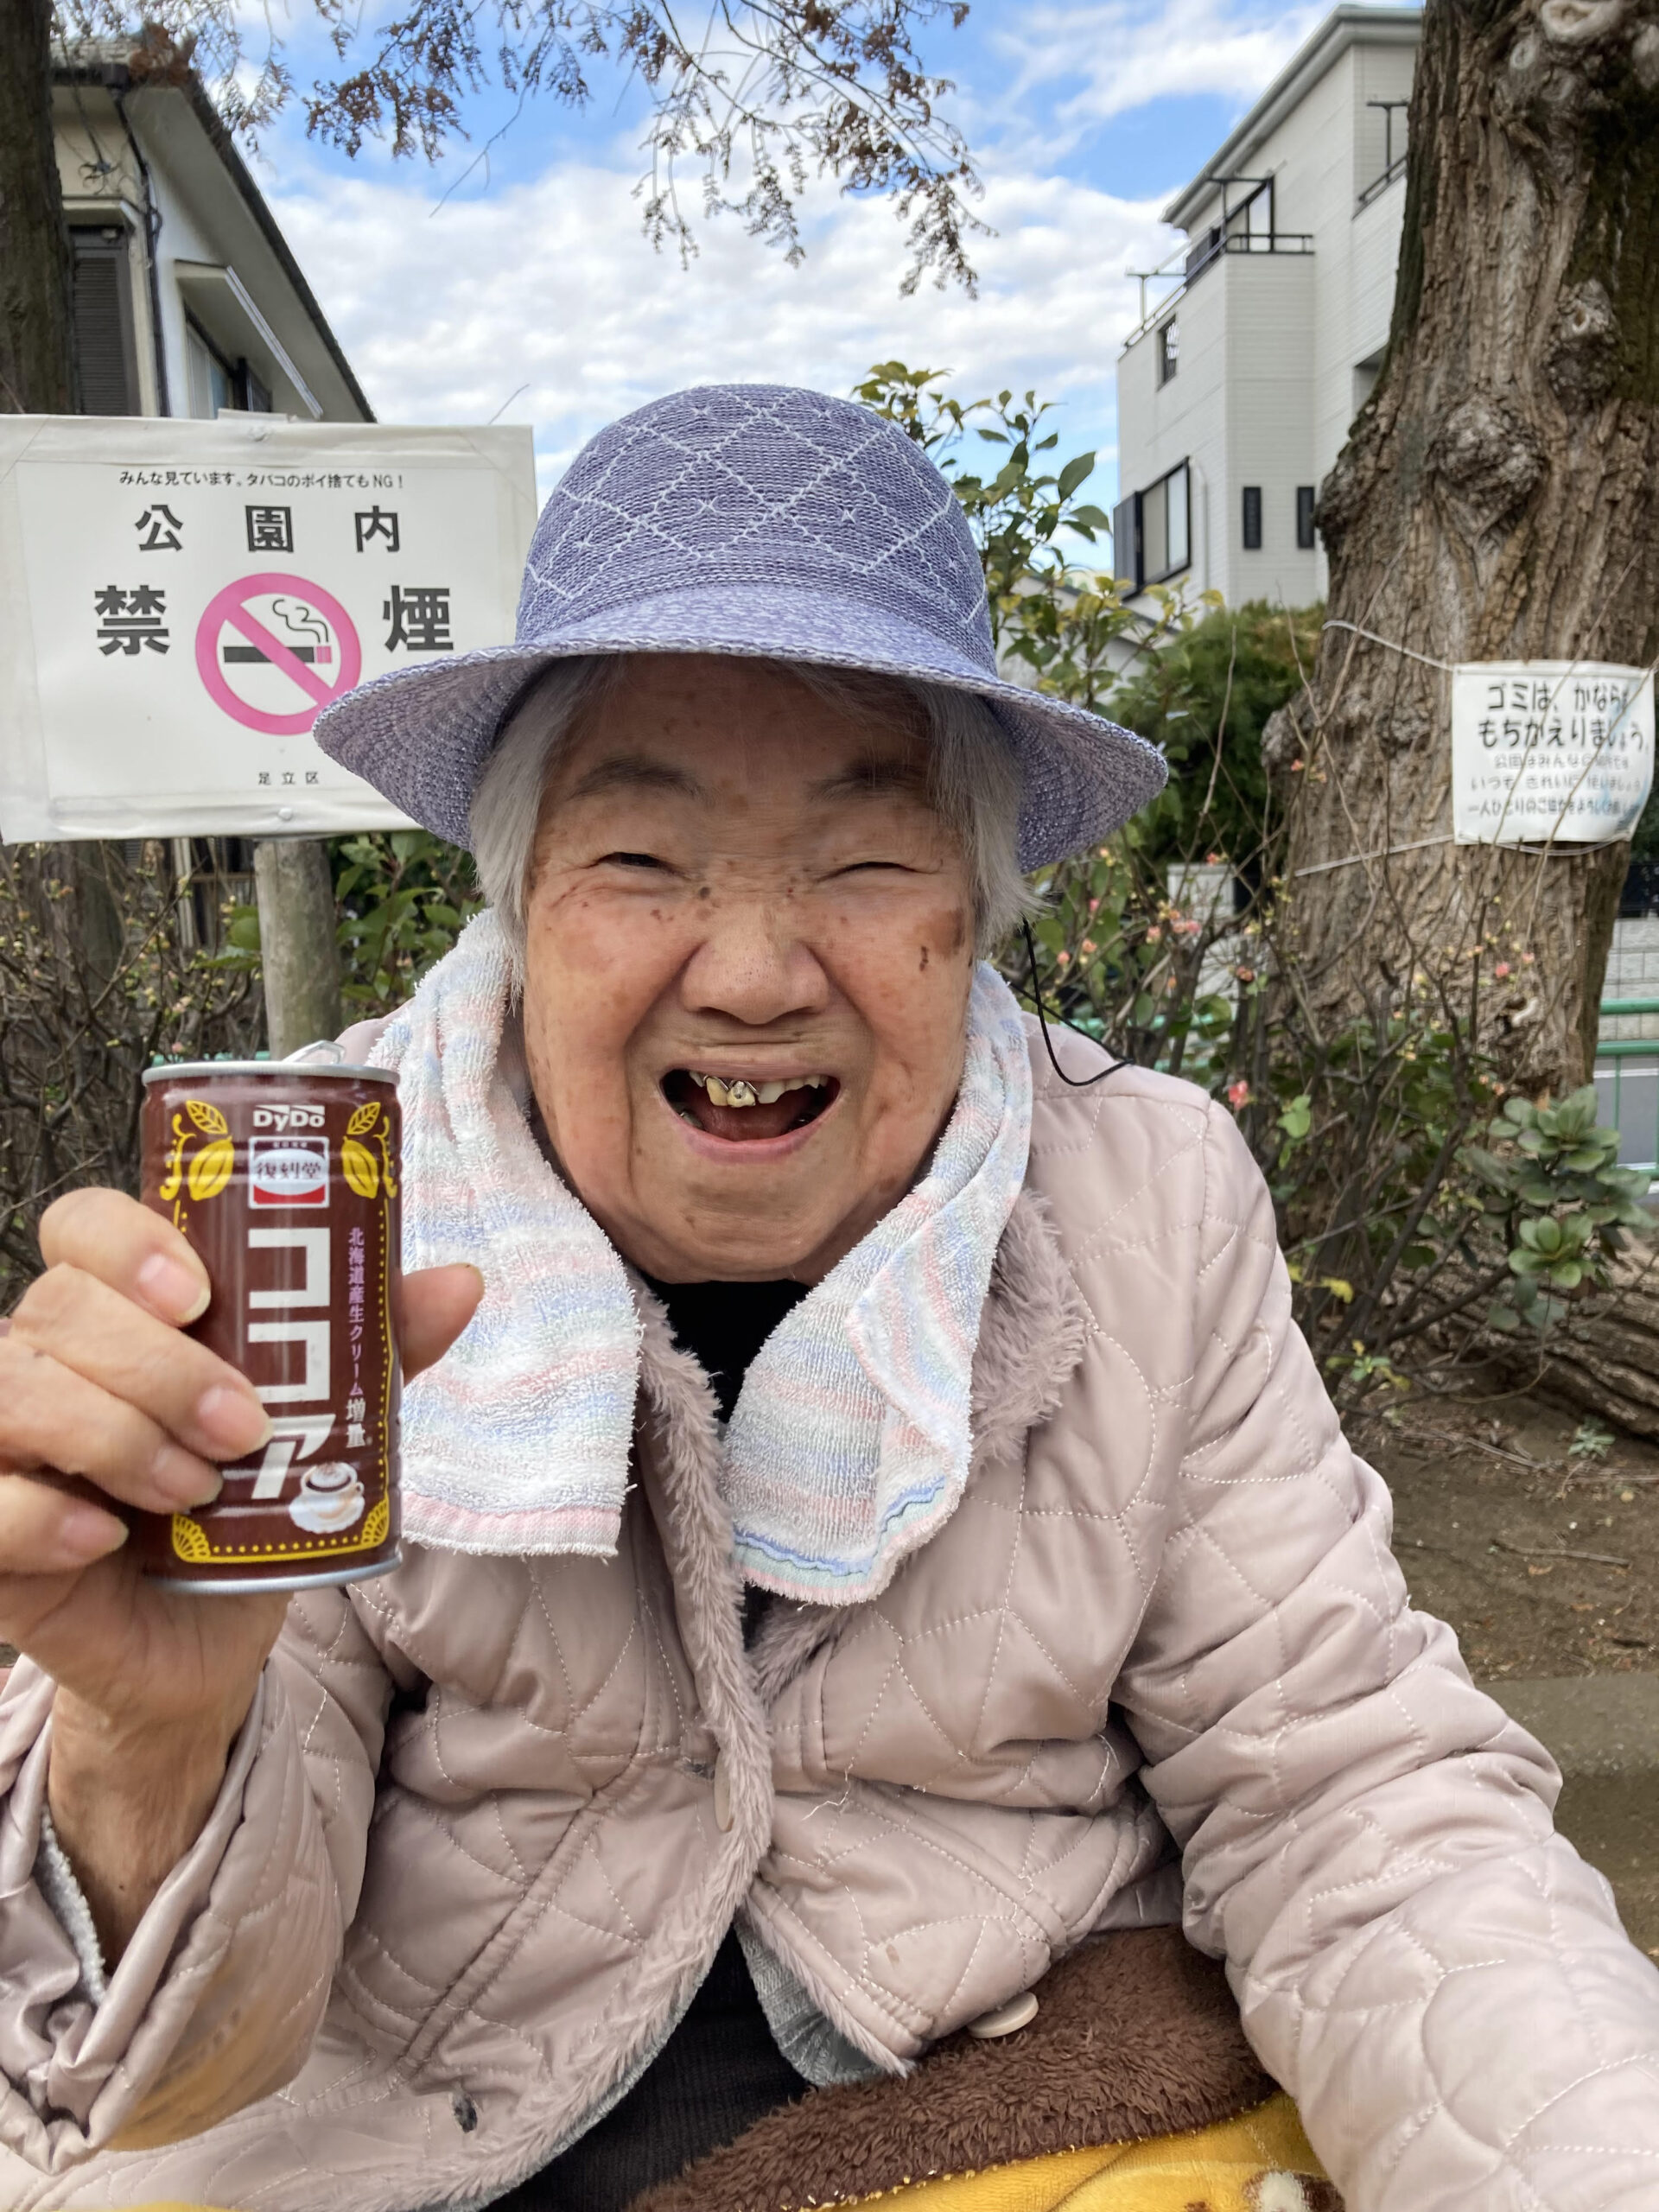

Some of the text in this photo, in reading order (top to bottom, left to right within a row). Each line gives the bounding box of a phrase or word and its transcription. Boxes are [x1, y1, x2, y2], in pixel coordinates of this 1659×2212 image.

[94, 584, 454, 656] 禁 煙
[258, 771, 319, 785] 足立区
[253, 1105, 326, 1132] DyDo
[248, 1227, 336, 1500] ココア
